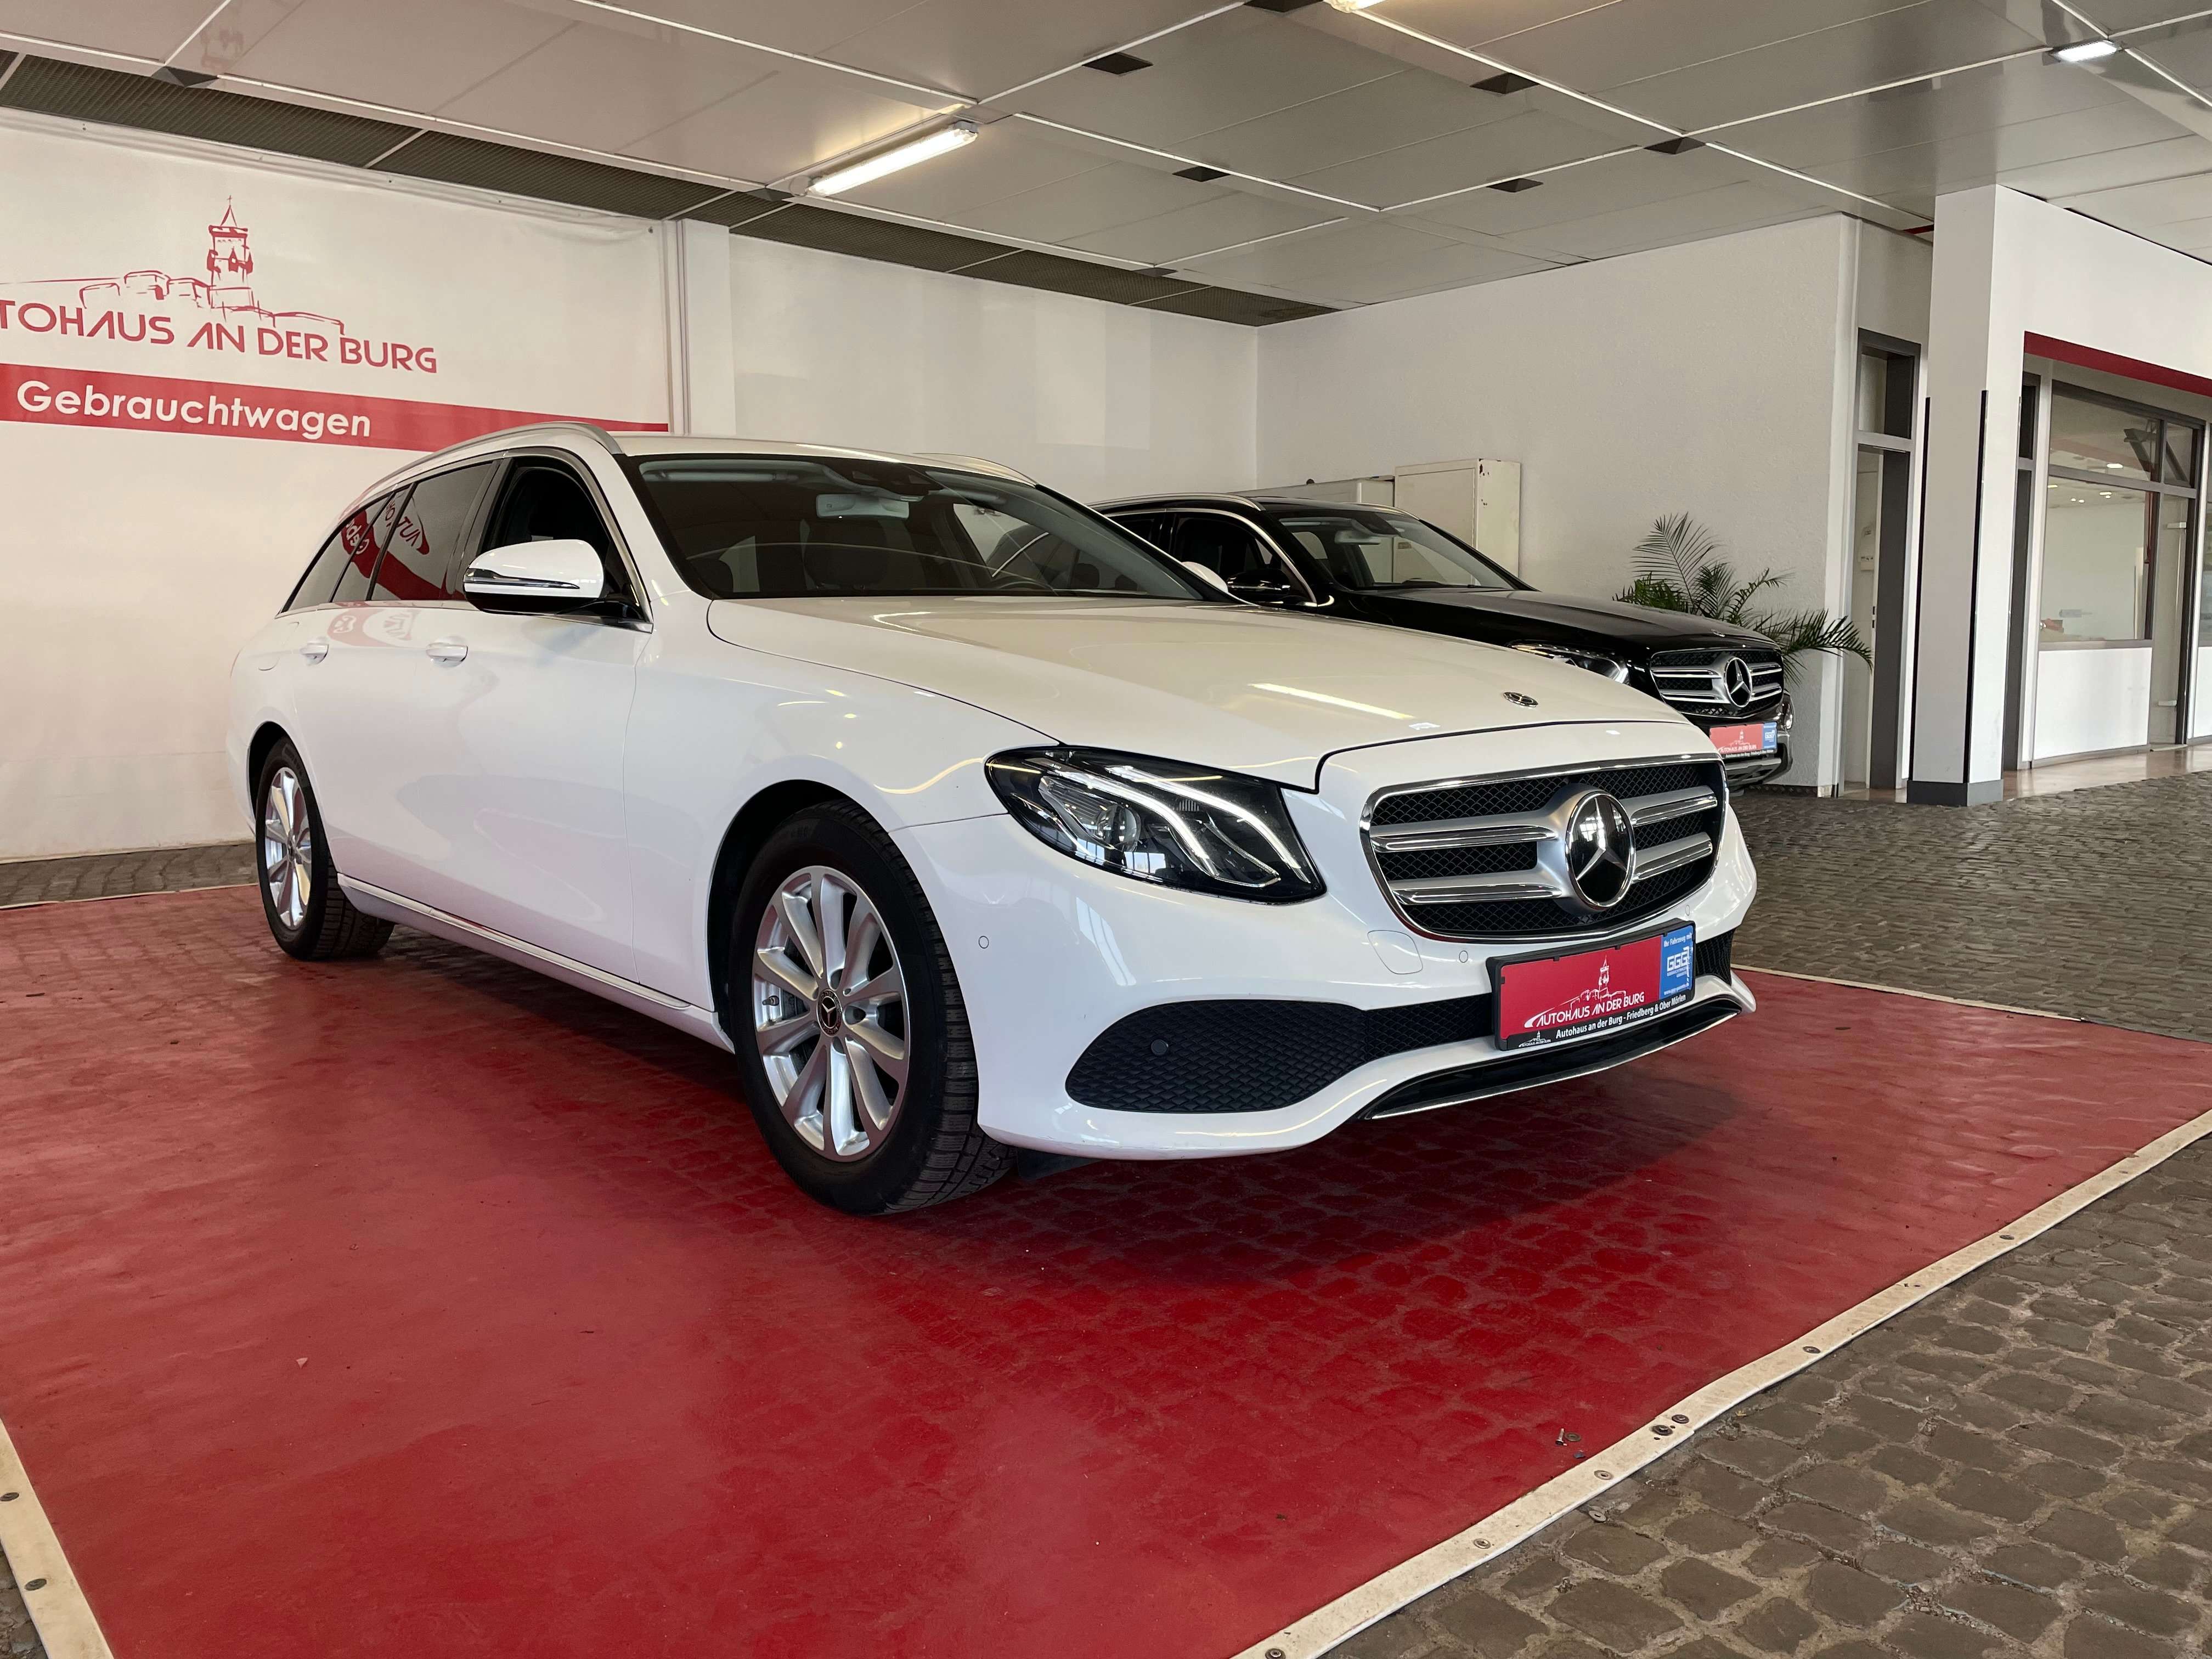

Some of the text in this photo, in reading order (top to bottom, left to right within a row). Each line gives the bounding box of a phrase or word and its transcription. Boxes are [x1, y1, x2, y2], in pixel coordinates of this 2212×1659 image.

[186, 322, 245, 353] AN
[257, 328, 329, 362] DER
[340, 337, 437, 374] BURG
[17, 380, 371, 440] Gebrauchtwagen
[1536, 992, 1645, 1028] AUTOHAUS AN DER BURG
[1556, 1025, 1588, 1039] Autohaus
[1588, 1022, 1596, 1031] an
[1597, 1019, 1608, 1028] der
[1609, 1015, 1623, 1026] Burg
[1627, 1007, 1654, 1021] Friedberg
[1654, 1004, 1659, 1012] &
[1659, 1001, 1671, 1011] Ober
